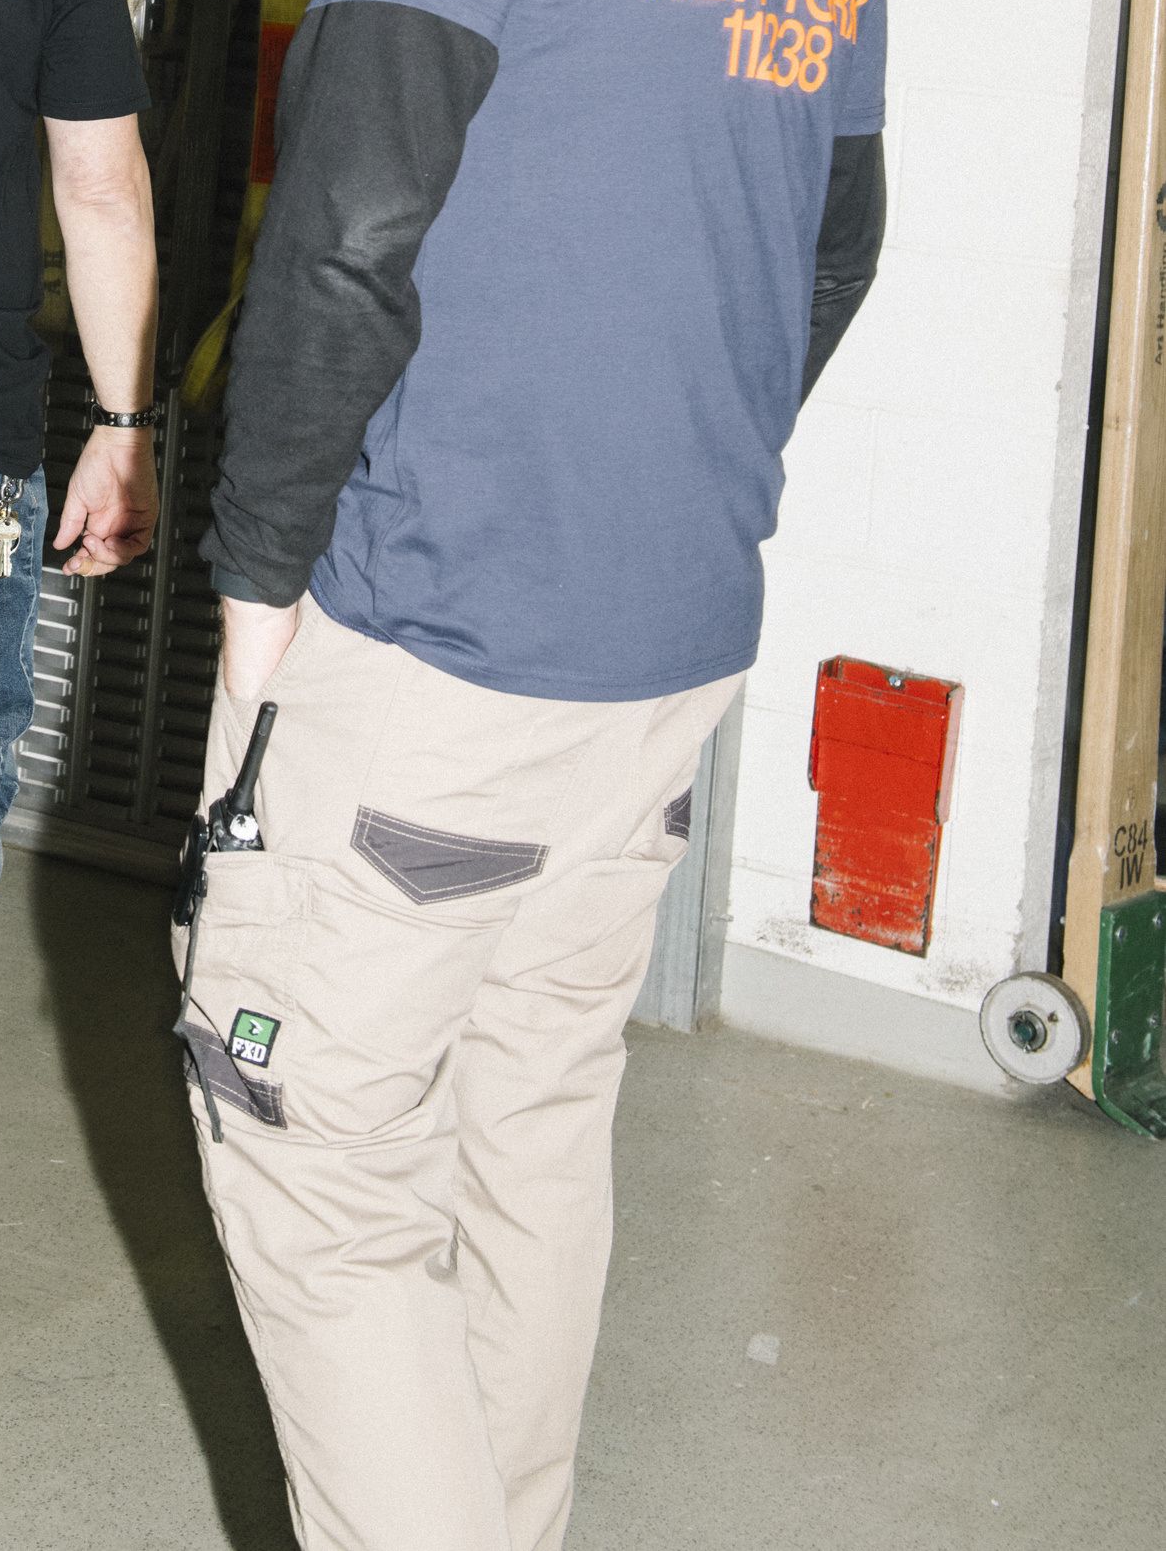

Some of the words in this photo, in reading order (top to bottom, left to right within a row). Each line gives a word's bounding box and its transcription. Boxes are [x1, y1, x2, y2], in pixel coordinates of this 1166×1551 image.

[723, 8, 833, 93] 11238
[1114, 820, 1147, 857] C84
[232, 1036, 267, 1063] FXD
